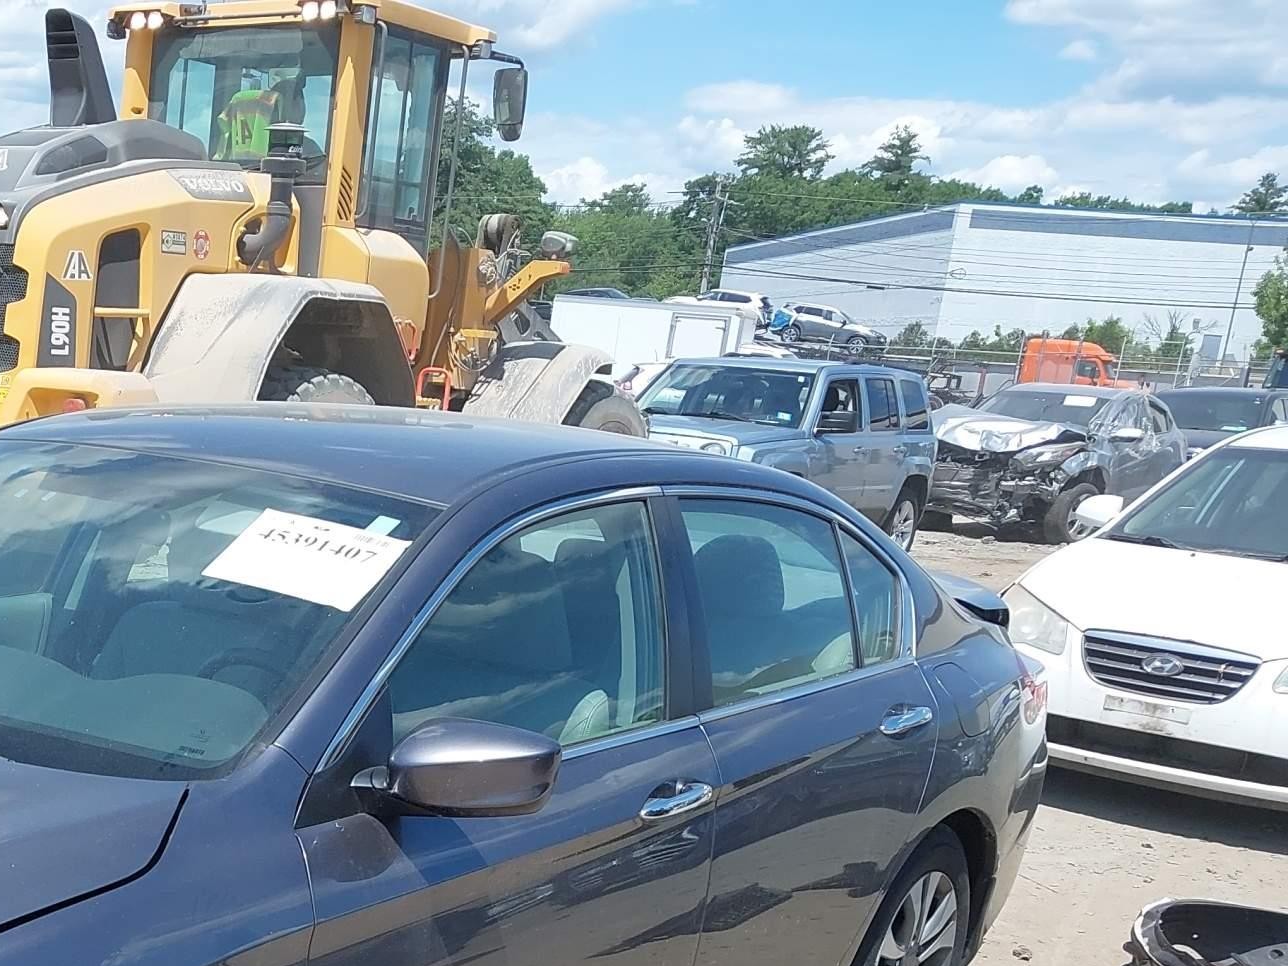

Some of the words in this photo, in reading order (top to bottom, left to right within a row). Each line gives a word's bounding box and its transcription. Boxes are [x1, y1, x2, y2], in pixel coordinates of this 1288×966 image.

[179, 177, 245, 193] VOLVO
[50, 306, 71, 356] L90H
[259, 528, 377, 563] 45391407
